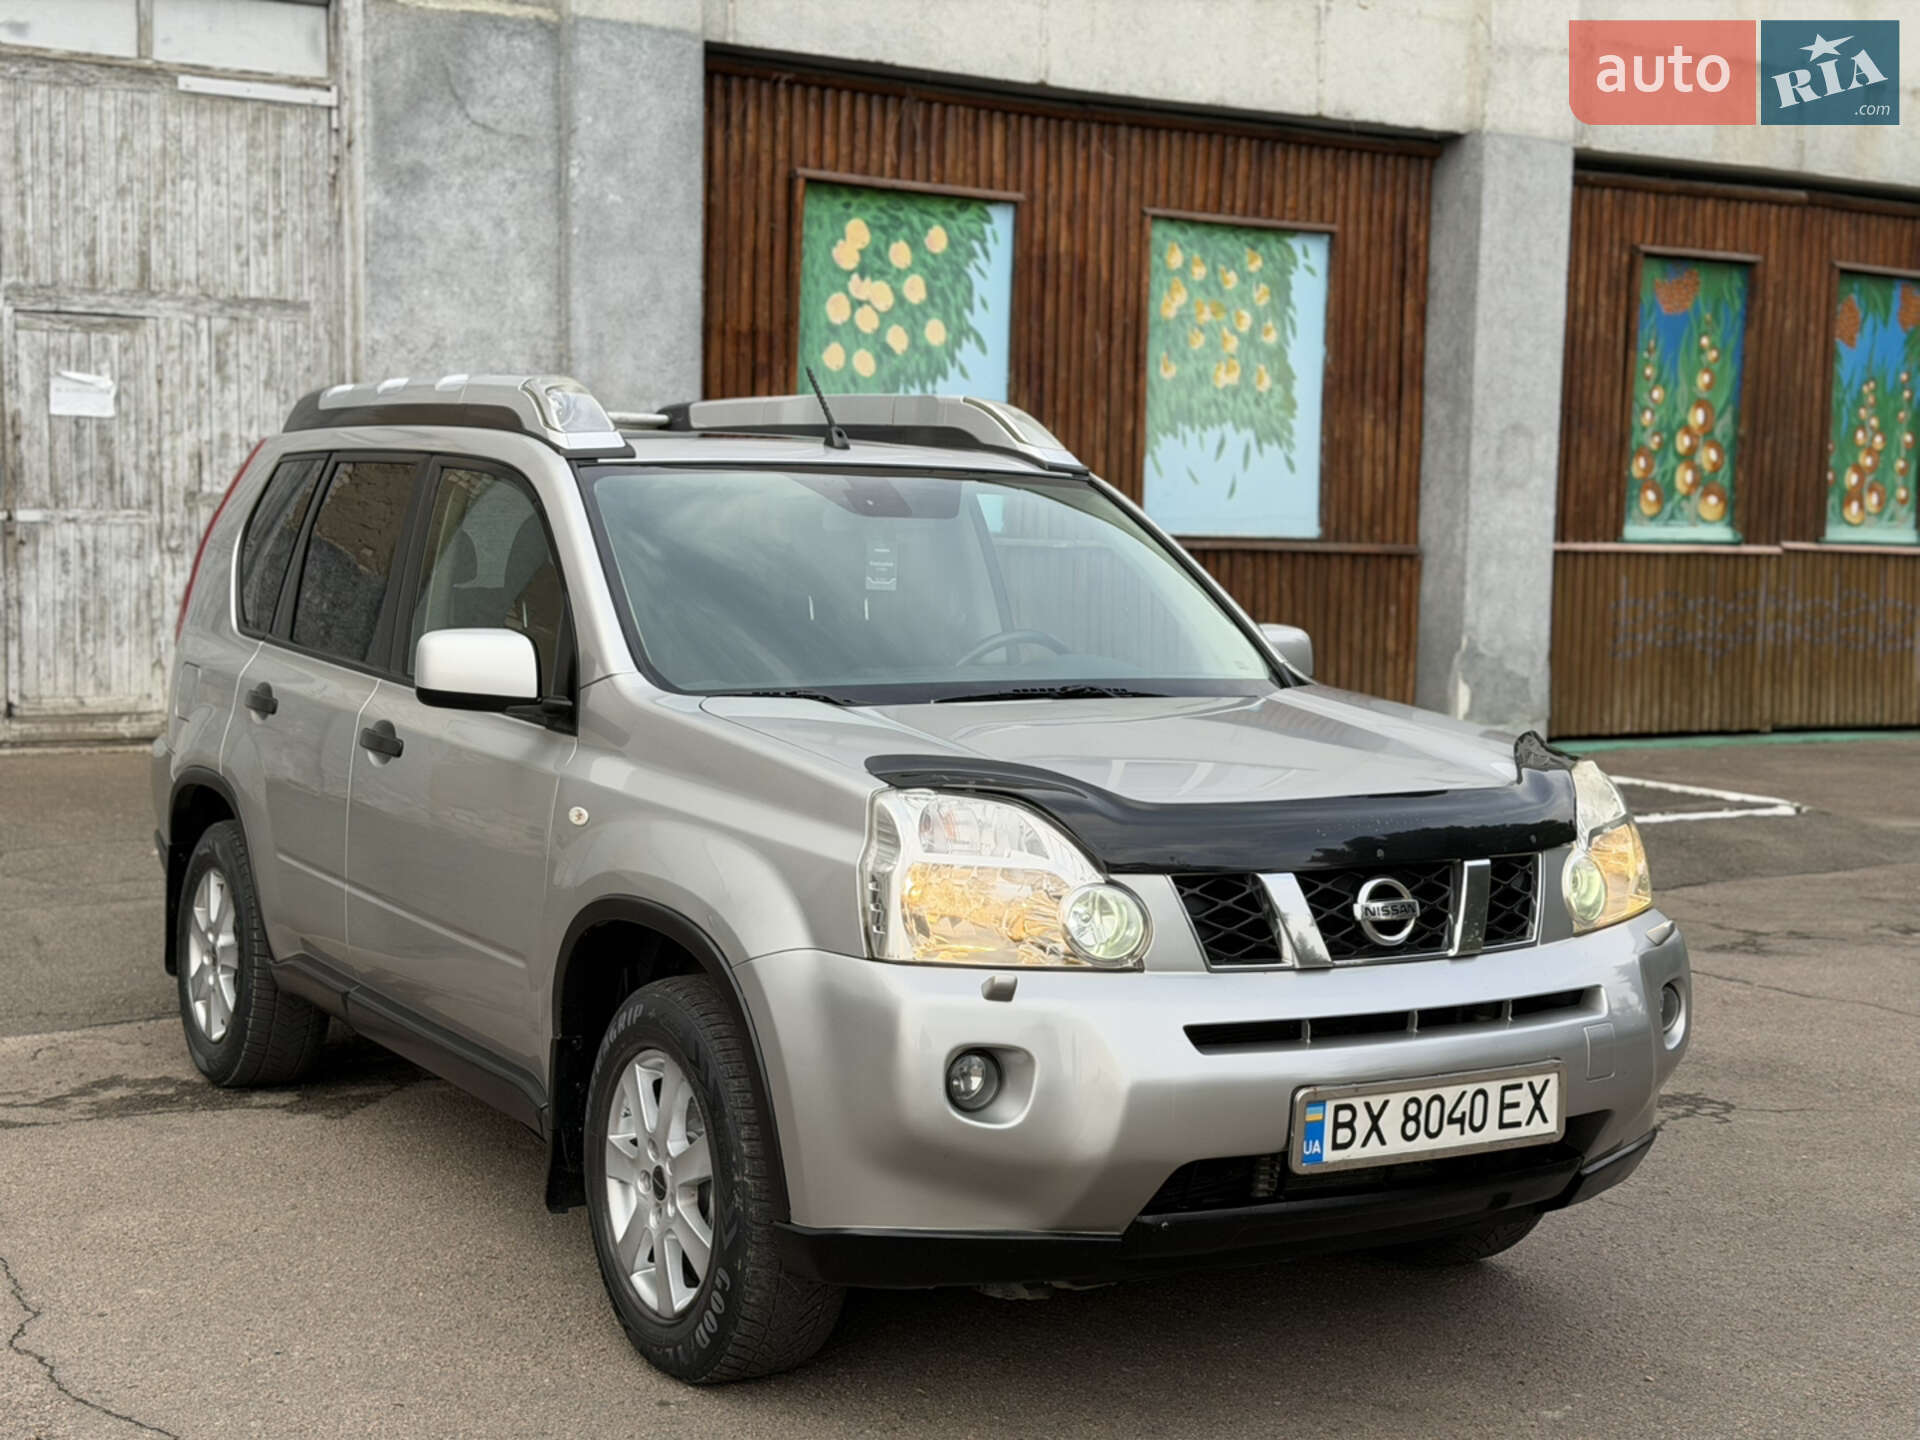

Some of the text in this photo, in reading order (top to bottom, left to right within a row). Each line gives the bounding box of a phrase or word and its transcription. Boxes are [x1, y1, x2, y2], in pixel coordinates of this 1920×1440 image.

[1363, 903, 1417, 917] NISSAN
[1331, 1078, 1551, 1151] BX 8040 EX
[1303, 1139, 1322, 1155] UA
